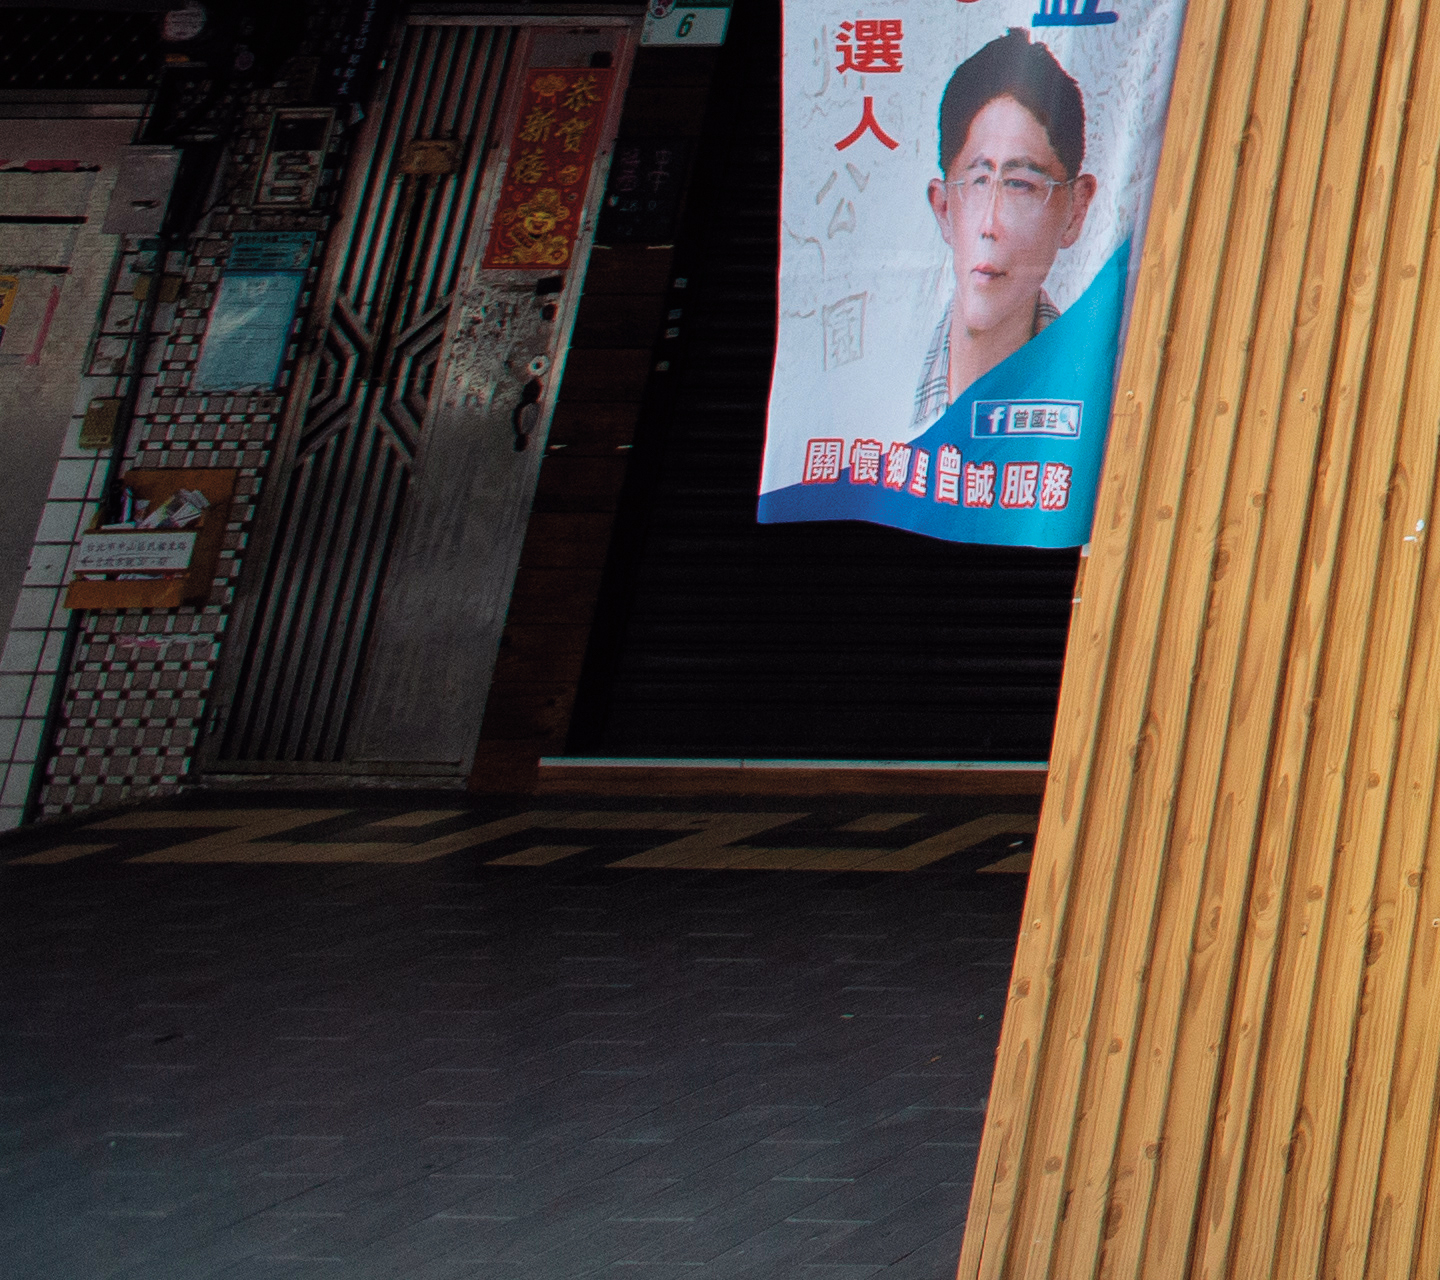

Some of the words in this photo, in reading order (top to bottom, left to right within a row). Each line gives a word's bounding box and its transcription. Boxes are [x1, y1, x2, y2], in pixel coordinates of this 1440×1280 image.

[676, 13, 696, 38] 6
[554, 73, 602, 153] 恭賀
[803, 438, 1073, 511] 關懷鄉里曾誠服務
